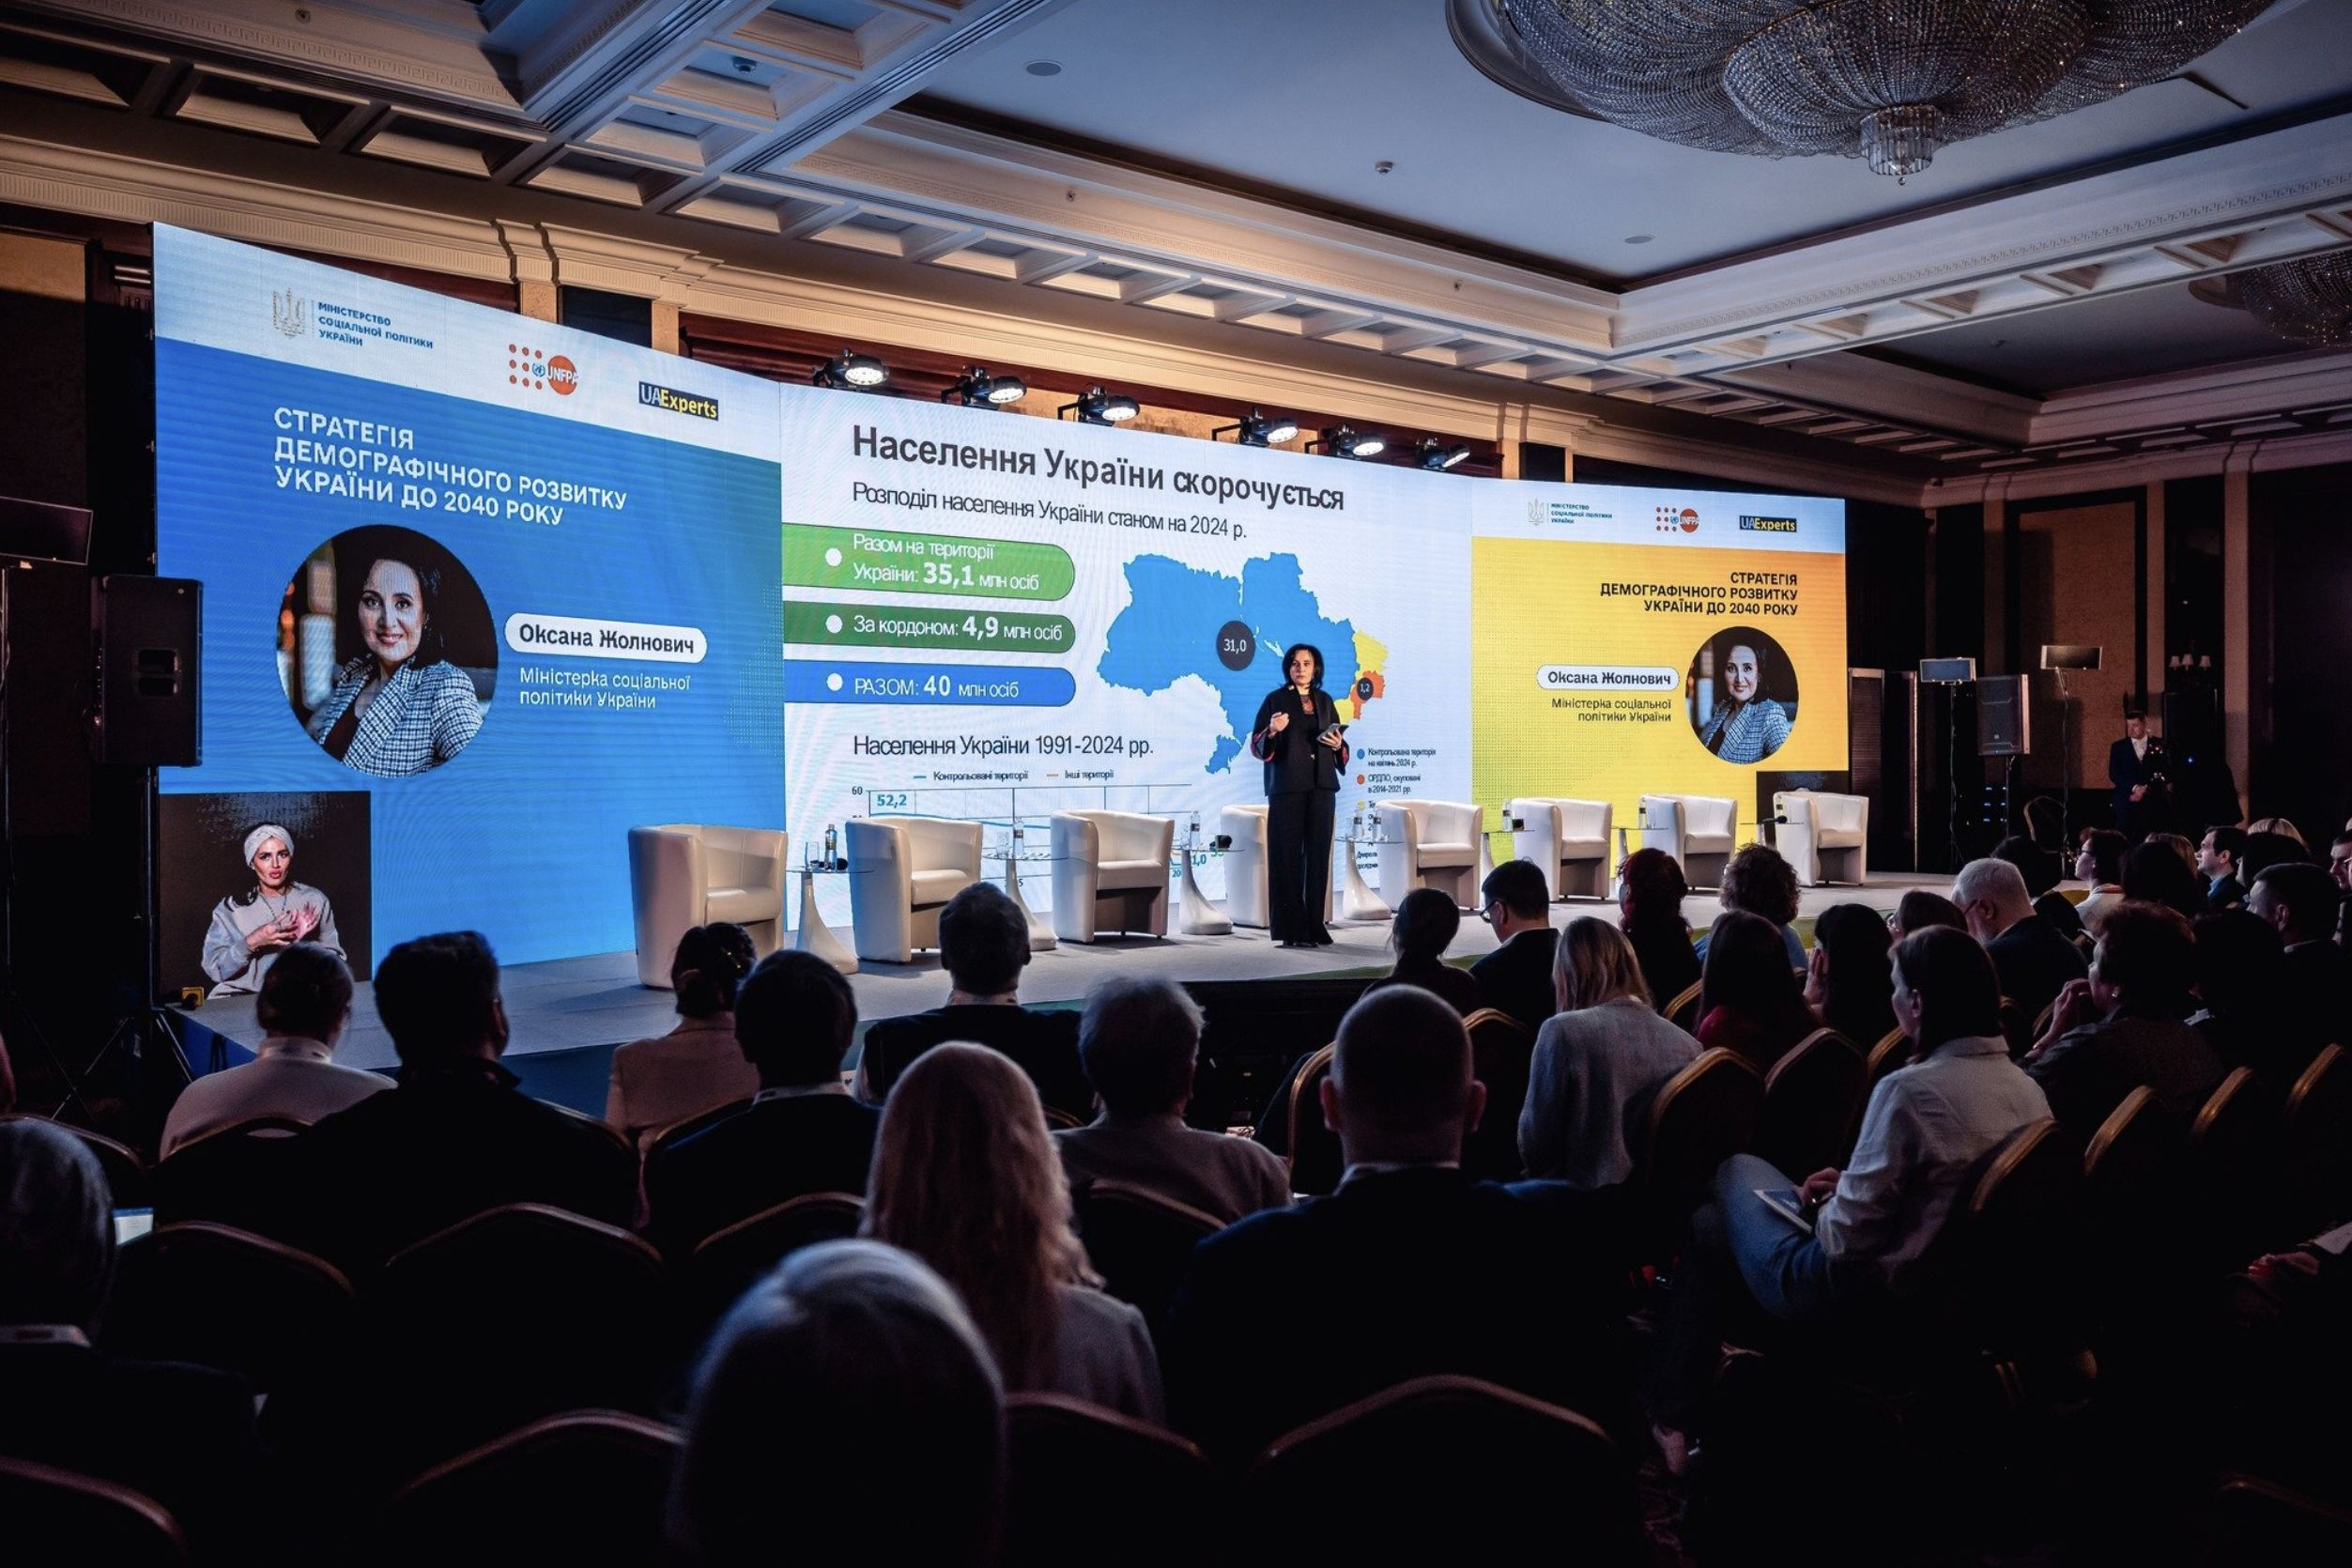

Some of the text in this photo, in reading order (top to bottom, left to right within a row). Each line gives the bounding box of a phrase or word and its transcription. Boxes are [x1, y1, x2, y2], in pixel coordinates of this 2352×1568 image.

[318, 301, 392, 326] МІНІСТЕРСТВО
[318, 316, 434, 349] СОЦІАЛЬНОЇ ПОЛІТИКИ
[318, 330, 363, 346] УКРАЇНИ
[547, 365, 578, 386] UNFPA
[640, 384, 717, 419] UAExperts
[274, 407, 414, 450] СТРАТЕГІЯ
[274, 437, 627, 511] ДЕМОГРАФІЧНОГО РОЗВИТКУ
[853, 424, 1345, 511] Населення України скорочується
[275, 465, 563, 526] УКРАЇНИ ДО 2040 РОКУ
[853, 481, 1248, 541] Розподіл населення України станом на 2024 р.
[1741, 516, 1796, 531] UAExperts
[853, 533, 995, 561] Разом на території
[853, 562, 1039, 591] України: 35,1 млн осіб
[1730, 572, 1798, 585] СТРАТЕГІЯ
[1600, 583, 1798, 601] ДЕМОГРАФІЧНОГО РОЗВИТКУ
[1643, 598, 1798, 616] УКРАЇНИ ДО 2040 РОКУ
[519, 623, 694, 653] Оксана Жолнович
[853, 615, 1063, 640] За кордоном: 4,9 млн осіб
[1223, 638, 1247, 654] 31,0
[519, 668, 691, 690] Міністерка соціальної
[854, 675, 1019, 698] РАЗОМ: 40 млн осіб
[1547, 671, 1671, 684] Оксана Жолнович
[1360, 684, 1370, 694] 1,2
[519, 690, 656, 711] політики України
[1551, 698, 1672, 712] Міністерка соціальної
[1578, 712, 1672, 724] політики України
[853, 735, 1154, 759] Населення України 1991-2024 рр.
[933, 771, 1029, 783] Контрольовані території
[1065, 769, 1115, 781] Інші території
[852, 786, 863, 795] 60
[877, 793, 907, 808] 52,2
